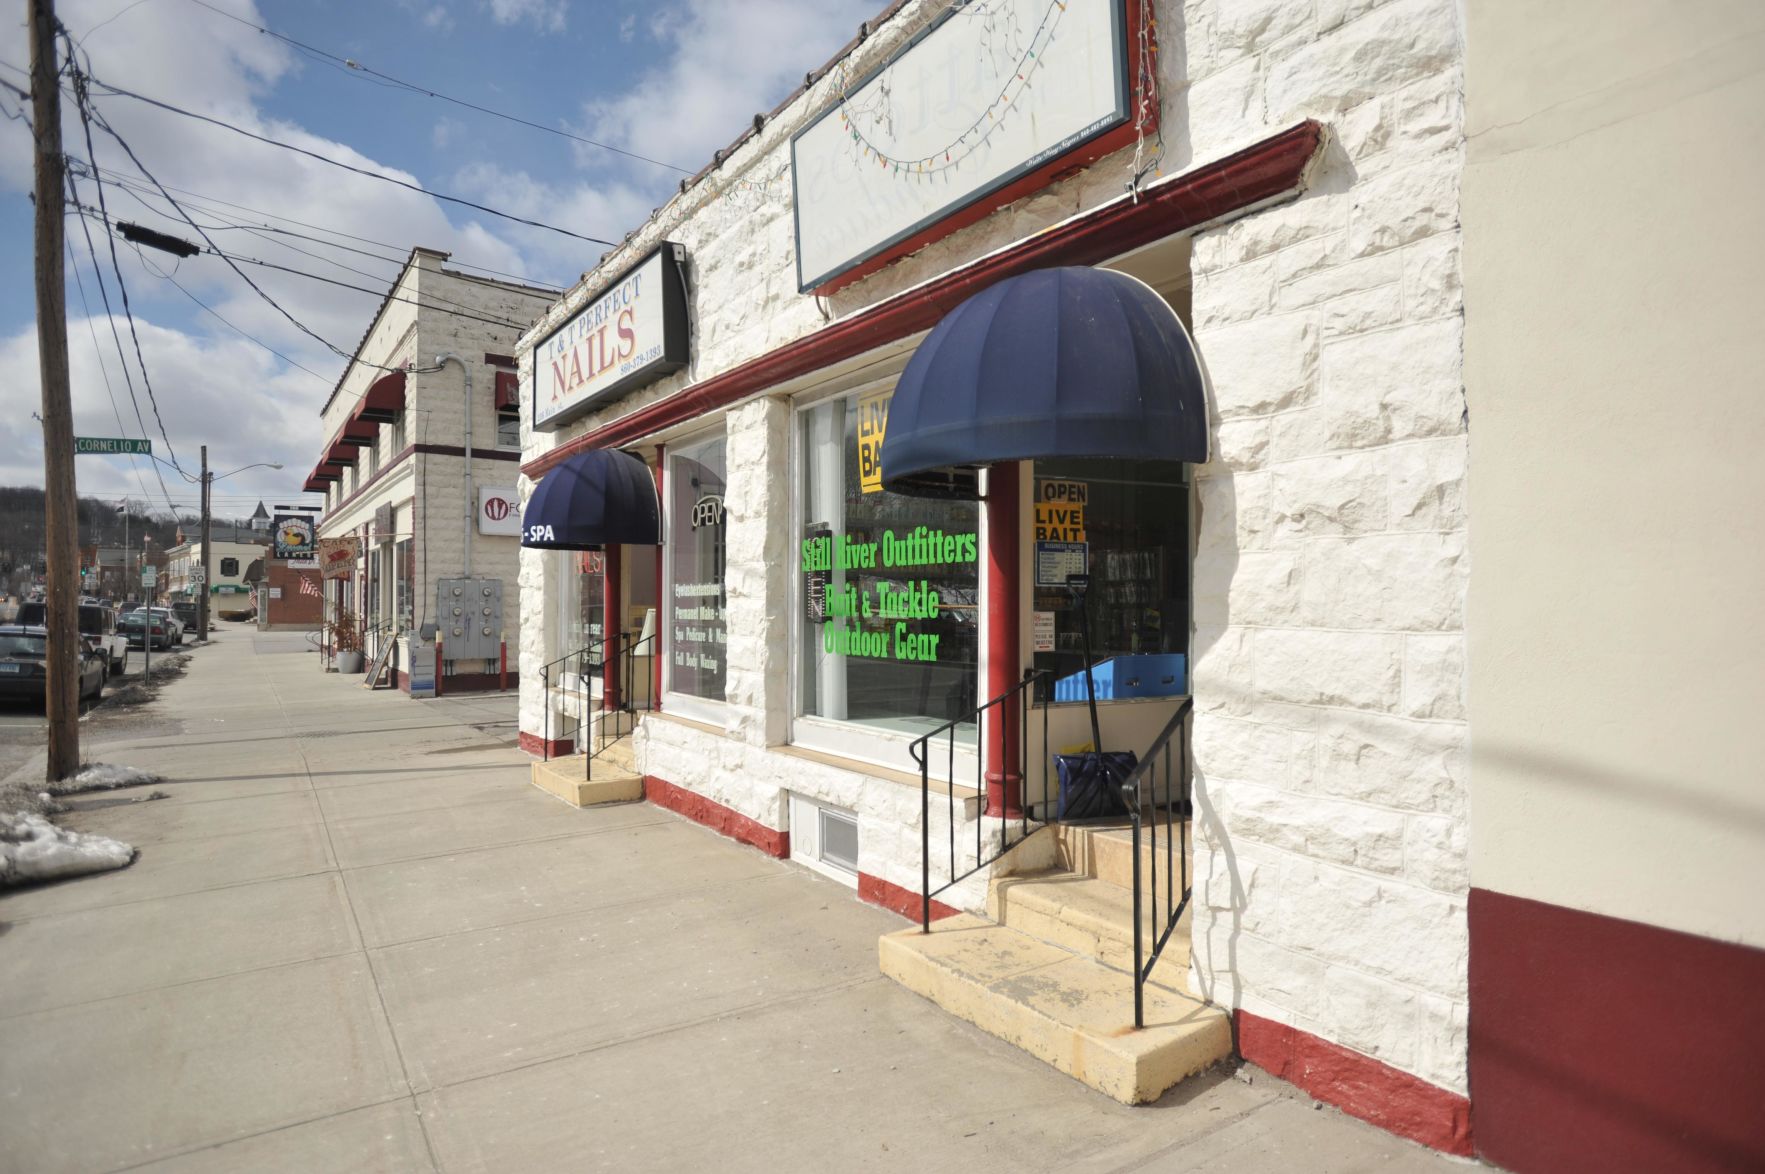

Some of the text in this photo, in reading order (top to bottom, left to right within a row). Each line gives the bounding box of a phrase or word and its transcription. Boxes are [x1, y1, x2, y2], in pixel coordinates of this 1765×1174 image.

[548, 273, 642, 360] T & T PERFECT
[551, 306, 636, 402] NAILS
[861, 399, 888, 437] LIV
[79, 439, 150, 453] CORNELIO AV
[862, 440, 882, 477] BA
[1044, 482, 1087, 503] OPEN
[691, 502, 721, 527] OPEN
[1035, 507, 1081, 525] LIVE
[529, 524, 555, 542] SPA
[1035, 526, 1082, 542] BAIT
[801, 526, 977, 572] Still River Outfitters
[190, 575, 204, 583] 30
[825, 580, 940, 620] Bait & Tackle
[824, 620, 940, 662] Outdoor Gear
